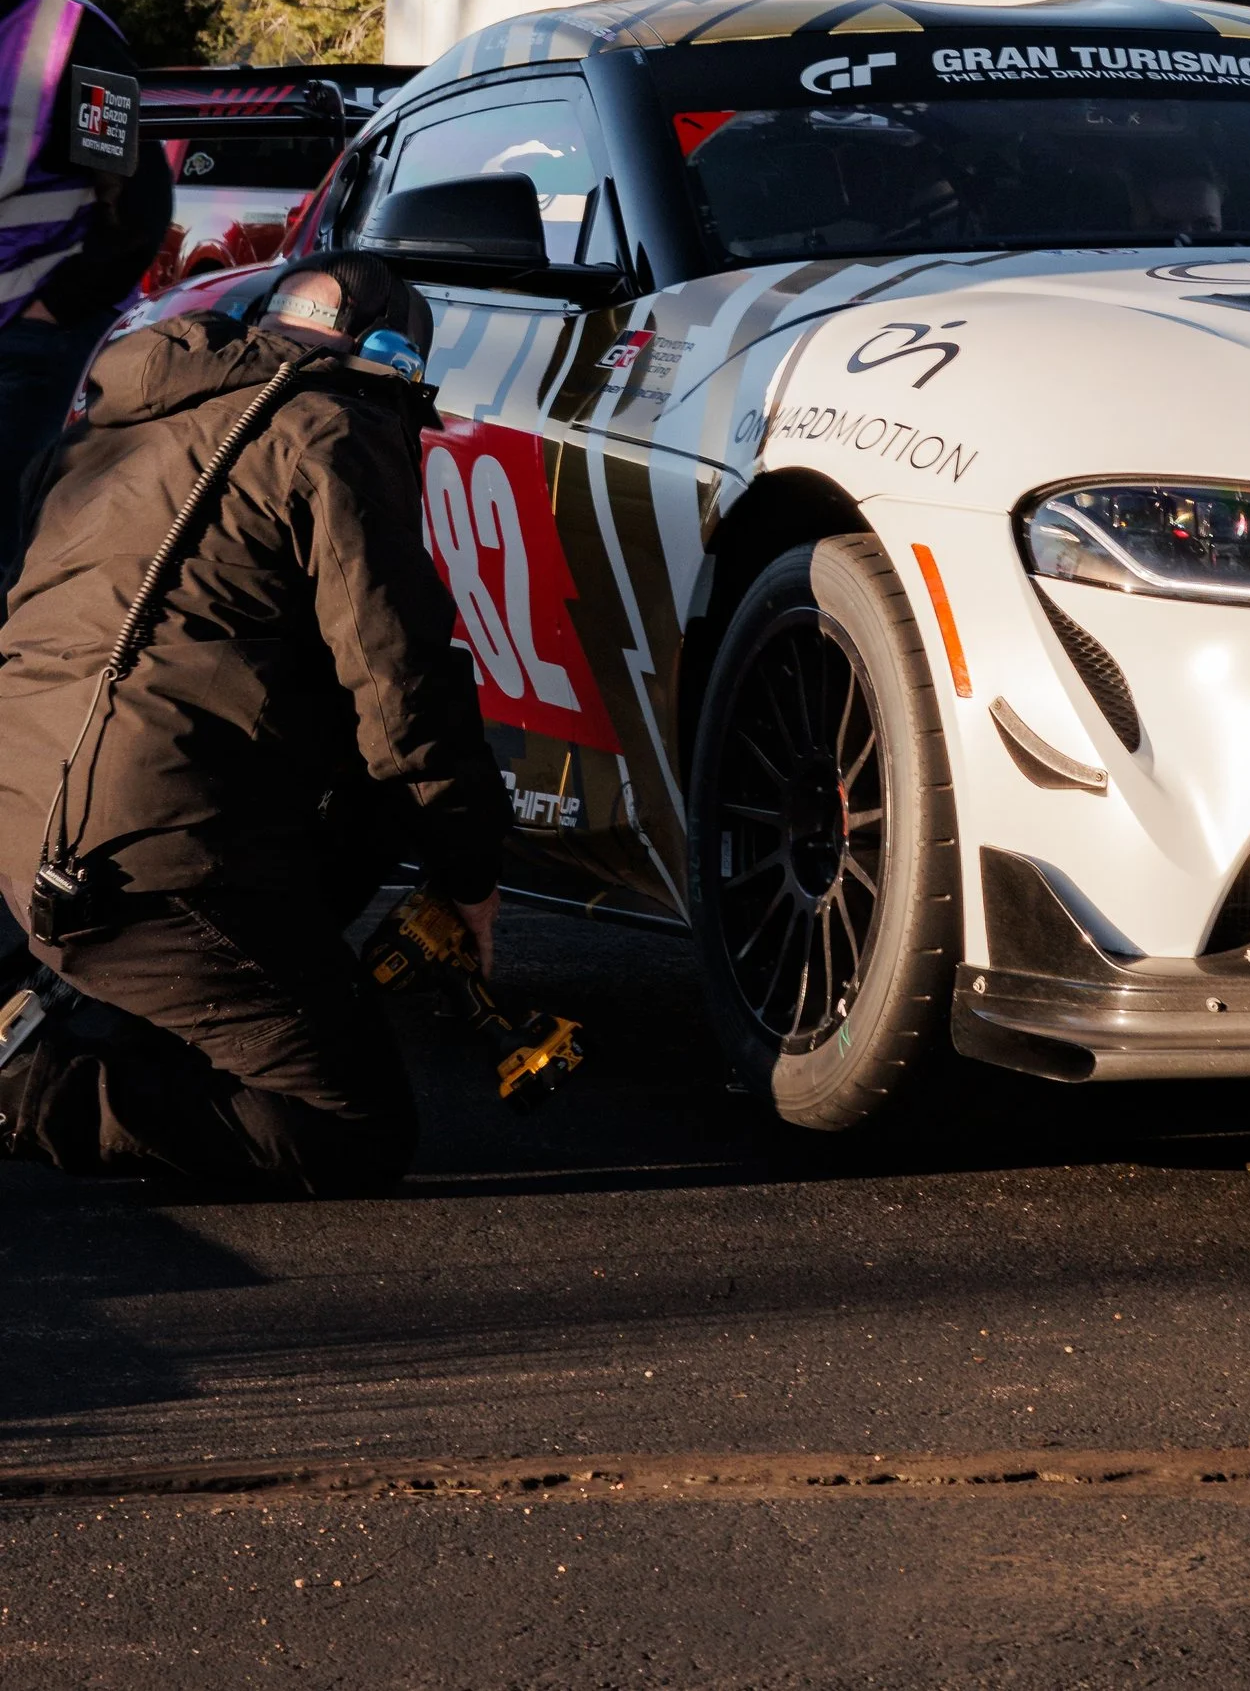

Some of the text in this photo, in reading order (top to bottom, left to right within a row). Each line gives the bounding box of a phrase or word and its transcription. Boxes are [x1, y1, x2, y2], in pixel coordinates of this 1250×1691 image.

[932, 47, 1058, 72] GRAN
[936, 71, 990, 83] THE
[988, 70, 1049, 81] REAL
[1051, 70, 1142, 80] DRIVING
[104, 90, 131, 110] TOYOTA
[79, 103, 101, 132] GR
[103, 107, 128, 125] GAZOO
[421, 446, 582, 712] 82
[560, 796, 581, 814] UP
